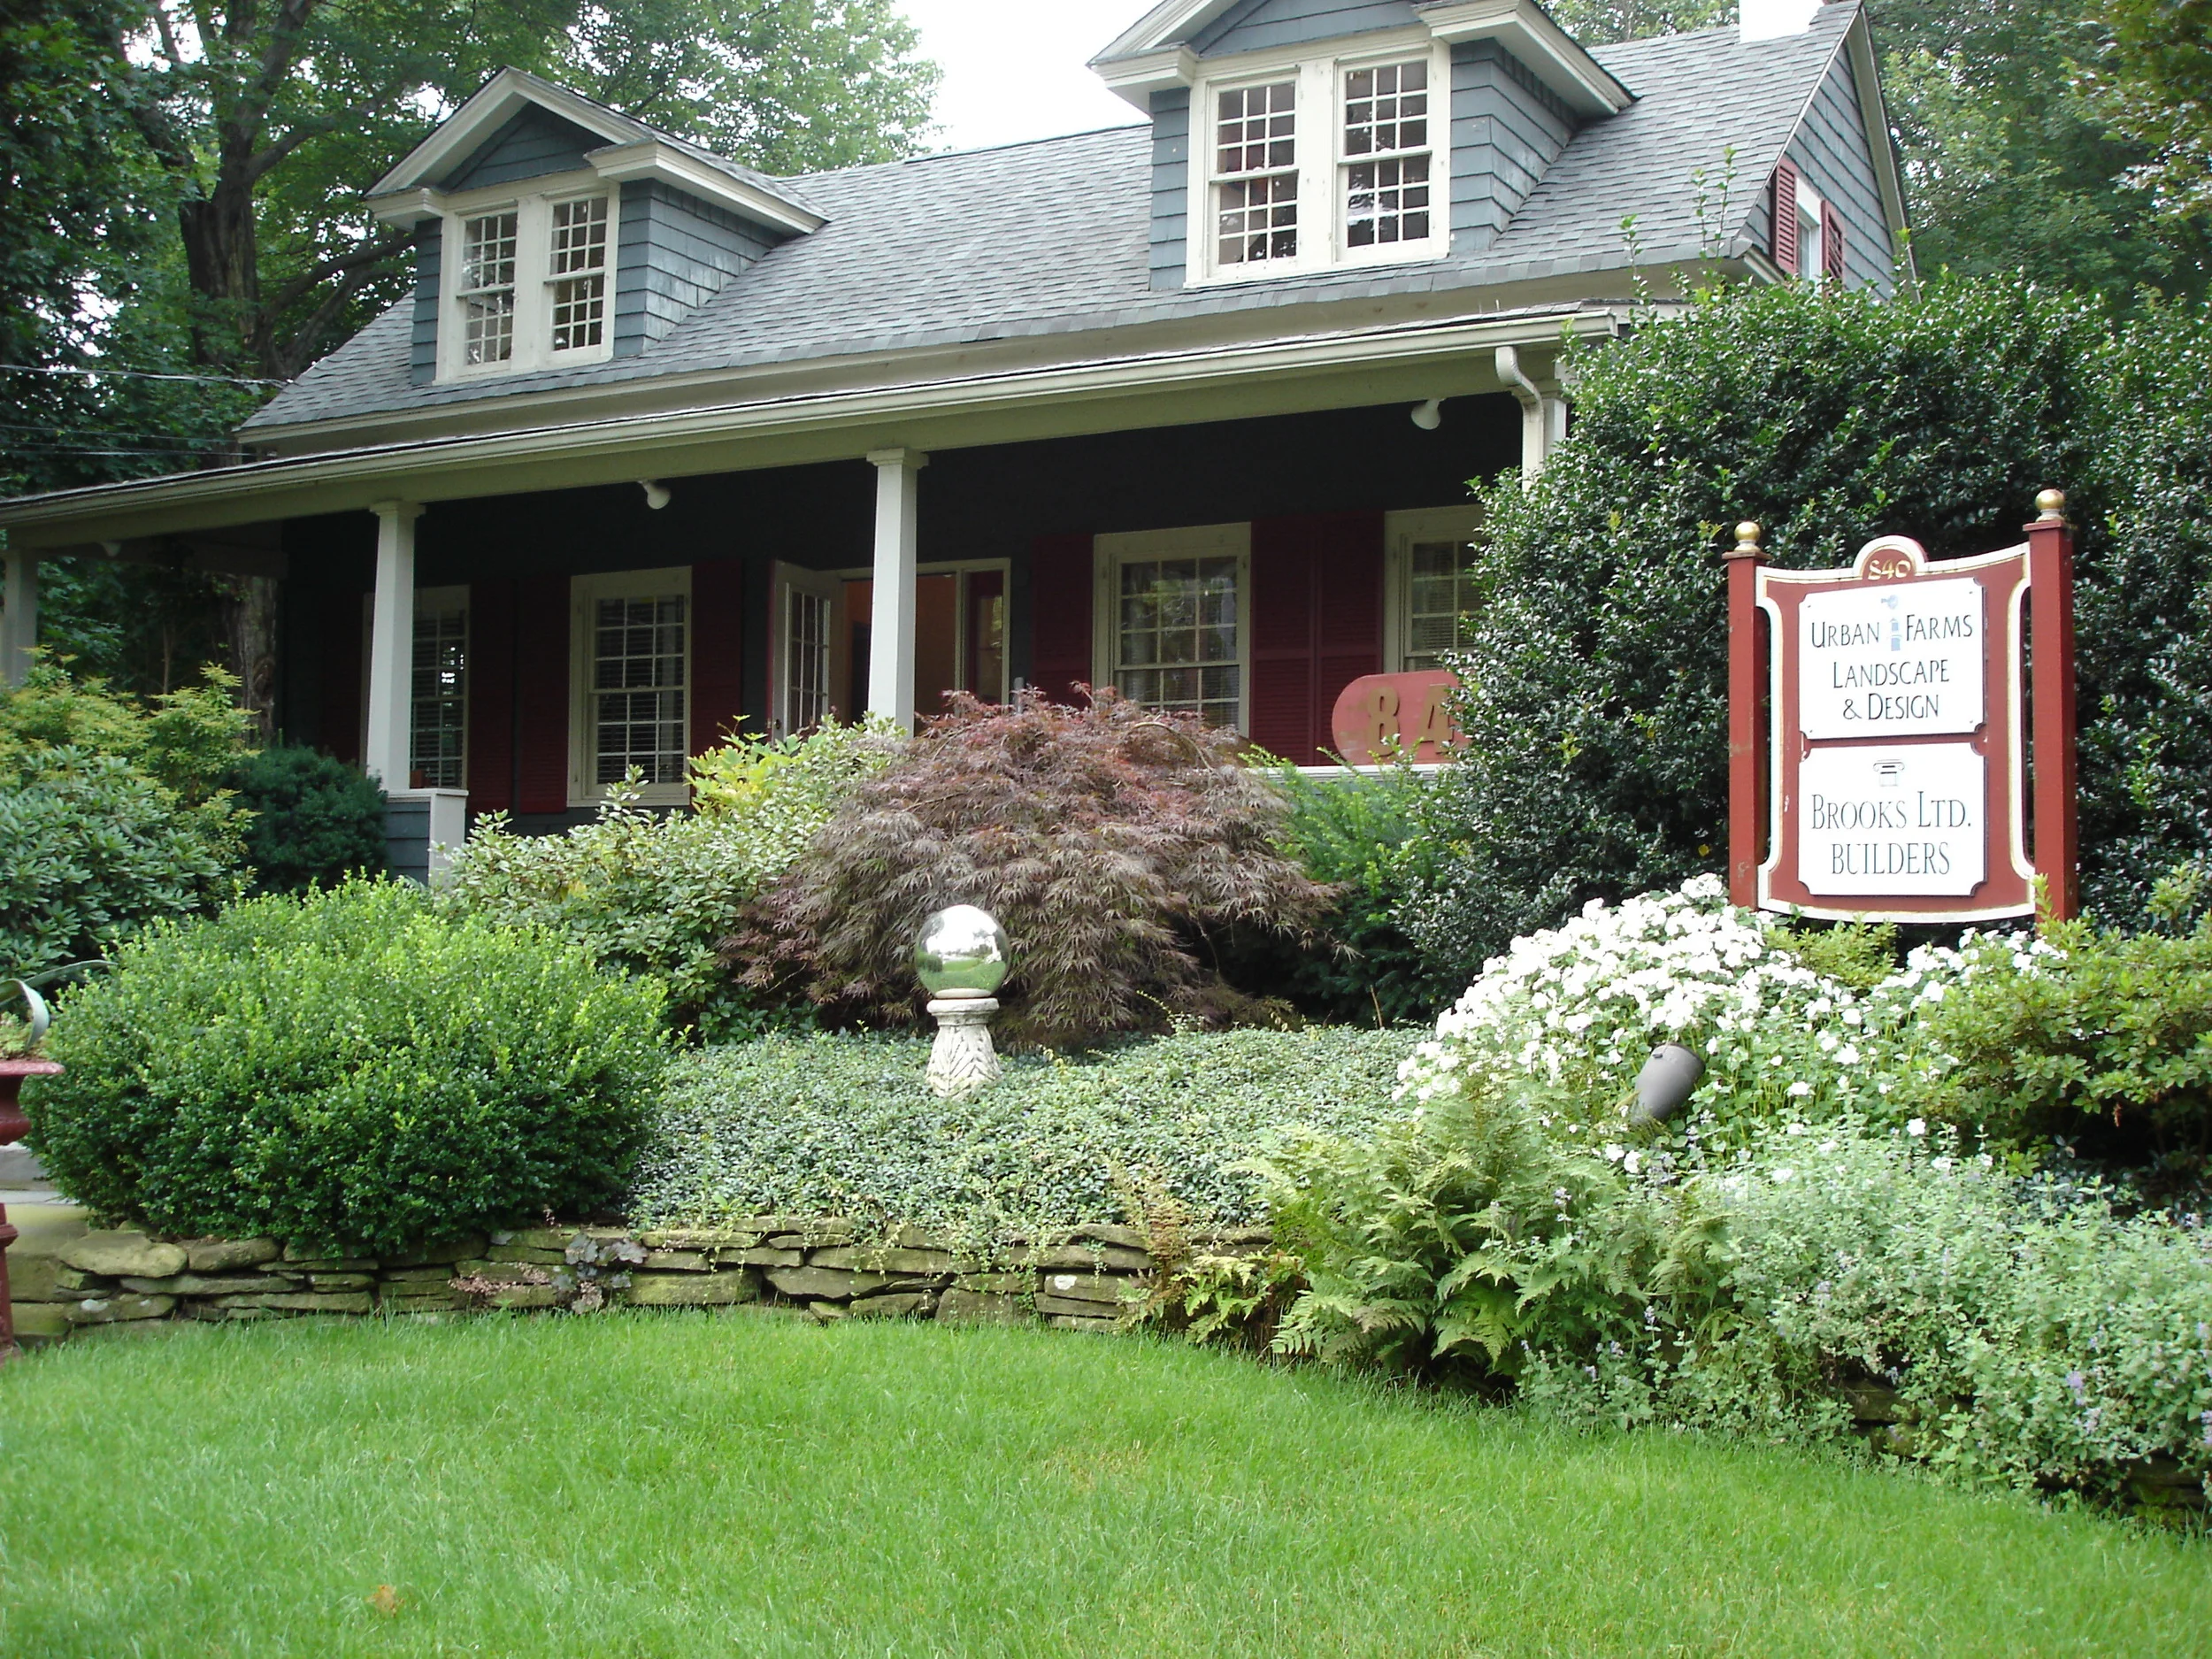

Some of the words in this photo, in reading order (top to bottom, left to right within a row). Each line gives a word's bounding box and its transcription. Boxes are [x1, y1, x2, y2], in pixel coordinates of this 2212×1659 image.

[1810, 621, 1879, 649] URBAN
[1905, 613, 1973, 642] FARMS
[1832, 659, 1949, 689] LANDSCAPE
[1842, 698, 1862, 719] &
[1867, 693, 1939, 721] DESIGN
[1811, 794, 1907, 830] BROOKS
[1916, 791, 1971, 828] LTD.
[1831, 842, 1950, 876] BUILDERS
